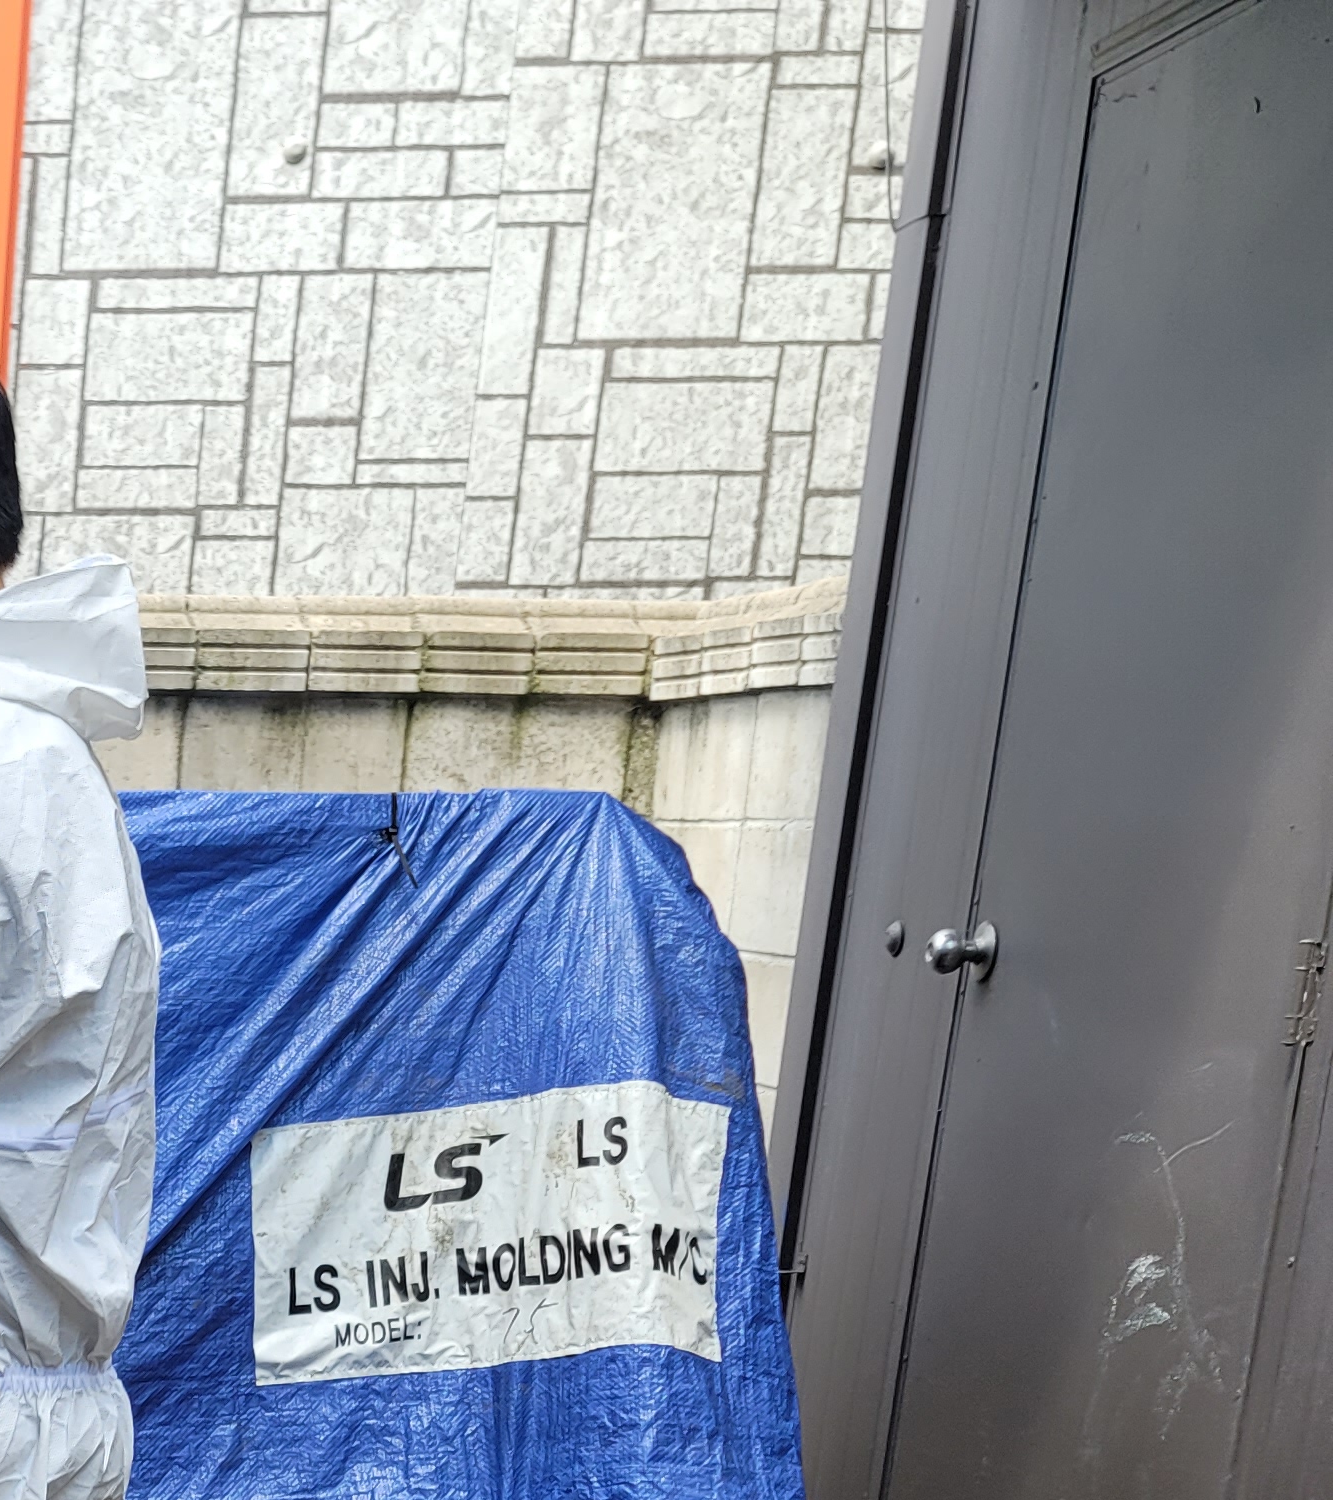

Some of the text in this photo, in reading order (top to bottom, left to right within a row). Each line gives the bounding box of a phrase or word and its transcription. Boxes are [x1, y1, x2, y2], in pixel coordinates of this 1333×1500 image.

[576, 1116, 629, 1169] LS
[384, 1141, 485, 1212] LS
[288, 1263, 341, 1316] LS
[366, 1250, 440, 1309] INJ.
[456, 1223, 632, 1297] MOLDING
[334, 1315, 423, 1348] MODEL:
